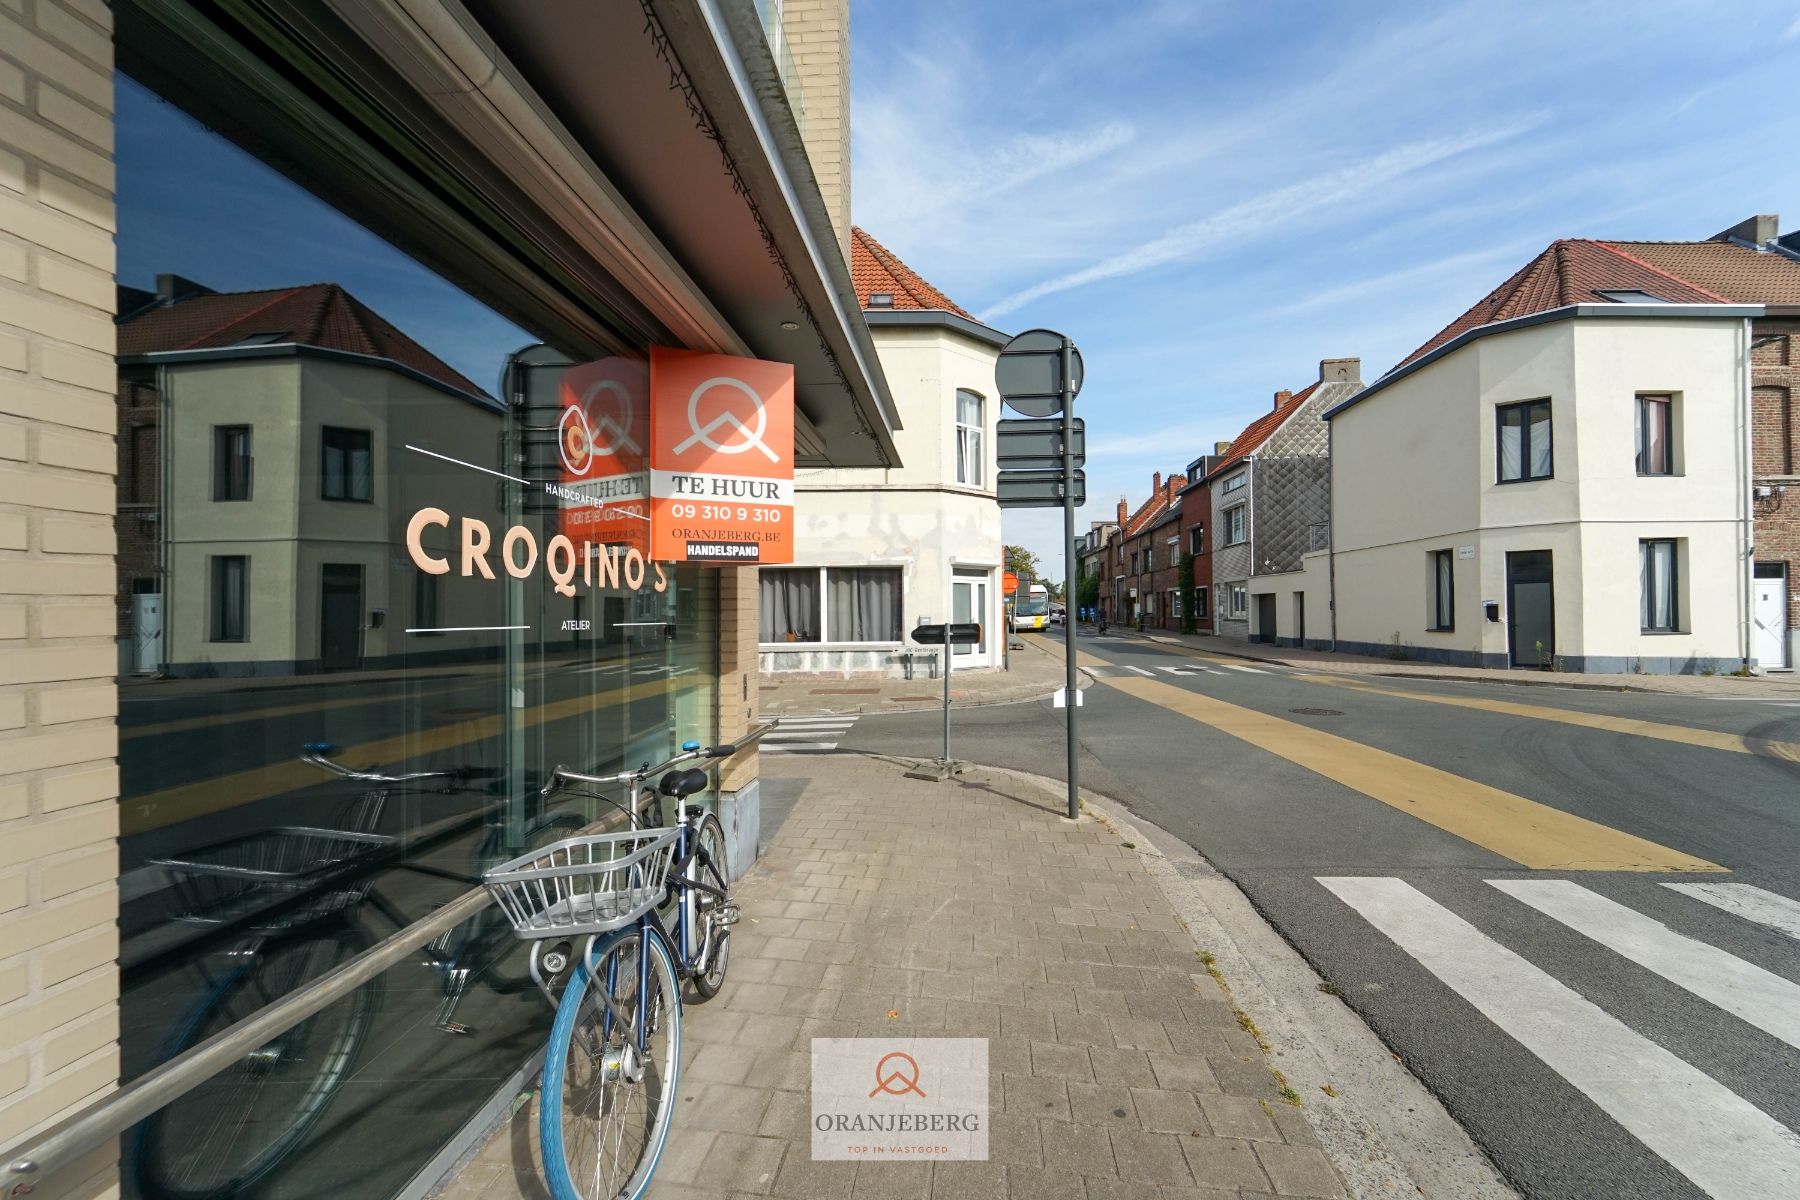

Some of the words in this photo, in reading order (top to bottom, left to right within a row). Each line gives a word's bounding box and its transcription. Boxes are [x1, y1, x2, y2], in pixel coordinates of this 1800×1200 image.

[545, 482, 604, 509] HANDCRAFTED
[672, 475, 704, 495] TE
[711, 478, 780, 499] HUUR
[671, 504, 696, 518] 09
[702, 505, 731, 520] 310
[737, 507, 748, 520] 9
[753, 508, 781, 522] 310
[671, 528, 781, 542] ORANJEBERG.BE
[406, 507, 667, 598] CROQINO'S
[687, 544, 759, 557] HANDELSPAND
[561, 620, 591, 631] ATELIER
